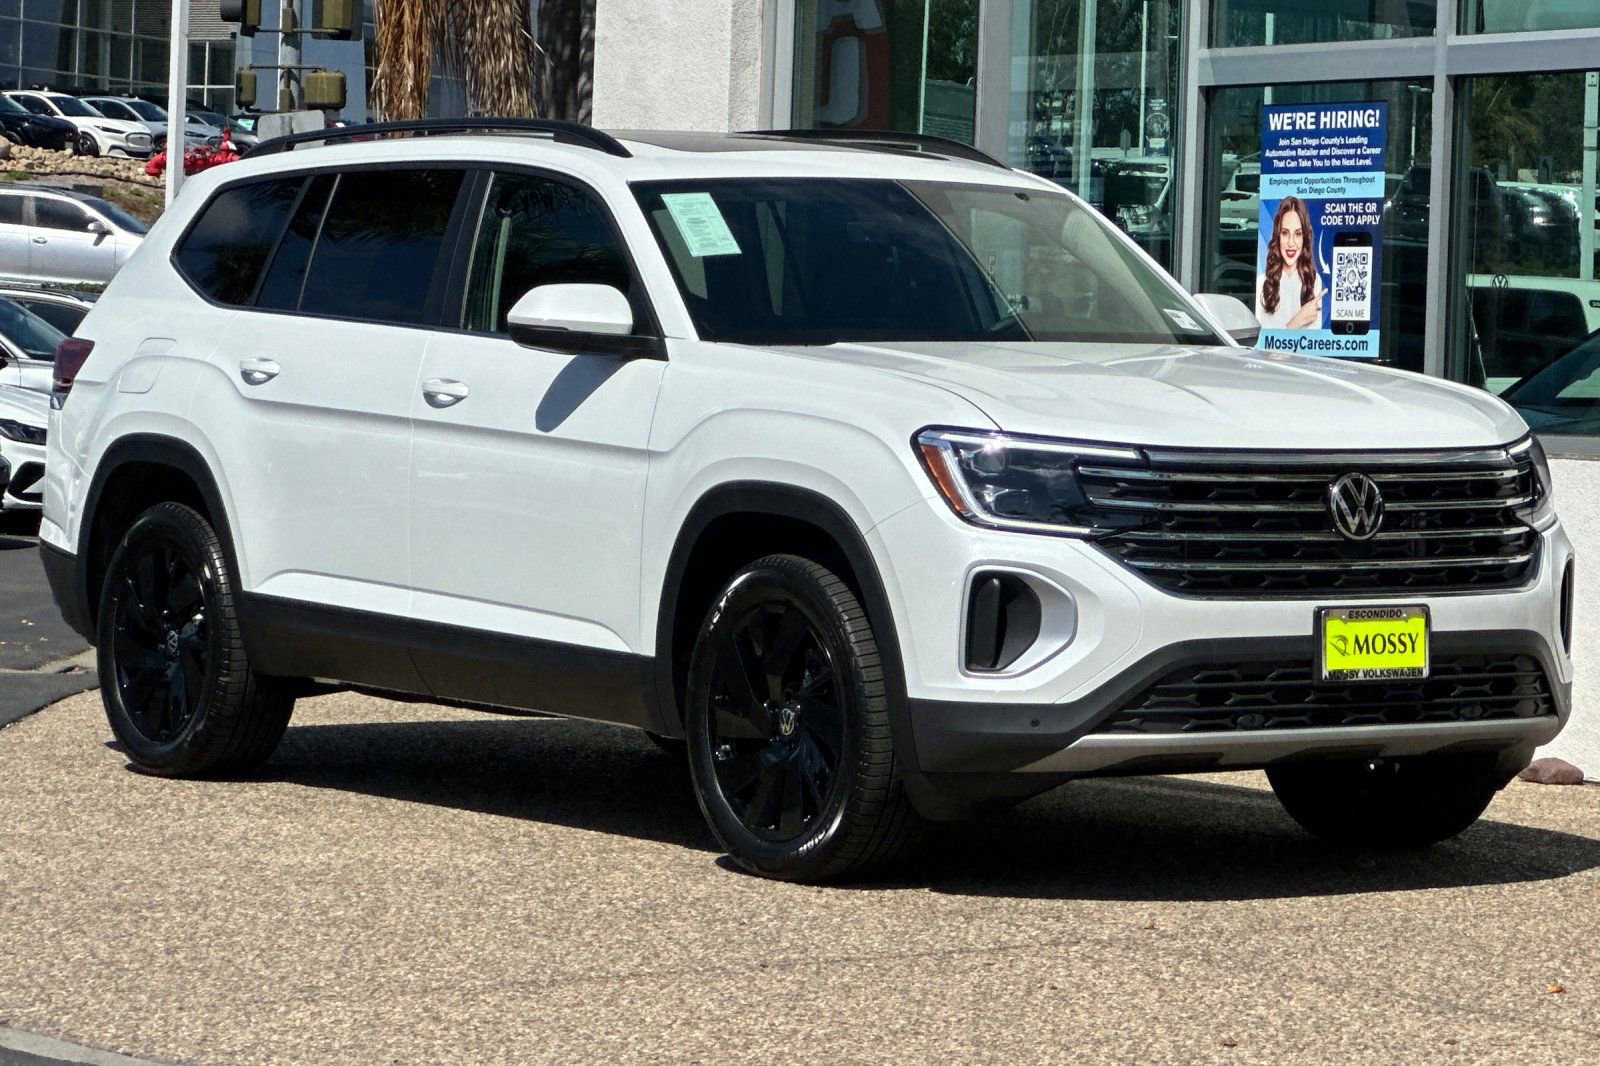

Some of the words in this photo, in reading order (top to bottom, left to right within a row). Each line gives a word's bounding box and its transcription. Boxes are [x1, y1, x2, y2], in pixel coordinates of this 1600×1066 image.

[1269, 112, 1316, 131] WE'RE
[1320, 109, 1380, 129] HIRING!
[1279, 138, 1290, 146] Join
[1303, 137, 1320, 146] Diego
[1320, 136, 1345, 146] County's
[1346, 136, 1368, 145] Leading
[1265, 149, 1296, 157] Automotive
[1297, 148, 1318, 156] Retailer
[1331, 147, 1356, 155] Discover
[1362, 146, 1382, 154] Career
[1273, 160, 1285, 168] That
[1286, 159, 1297, 167] Can
[1299, 159, 1311, 167] Take
[1312, 158, 1324, 167] You
[1332, 158, 1341, 166] the
[1342, 158, 1355, 166] Next
[1356, 157, 1372, 165] Level.
[1269, 178, 1302, 186] Employment
[1304, 177, 1342, 185] Opportunities
[1343, 176, 1375, 185] Throughout
[1296, 186, 1307, 194] San
[1309, 186, 1325, 195] Diego
[1326, 186, 1346, 194] County
[1325, 203, 1346, 213] SCAN
[1348, 203, 1363, 213] THE
[1365, 202, 1377, 213] QR
[1320, 215, 1343, 225] CODE
[1344, 215, 1355, 225] TO
[1356, 214, 1380, 225] APPLY
[1336, 309, 1354, 318] SCAN
[1355, 309, 1365, 318] ME
[1264, 335, 1368, 352] MossyCareers.com
[1348, 609, 1402, 619] ESCONDIDO
[1353, 632, 1419, 655] MOSSY
[1328, 669, 1360, 680] MOSSY
[1362, 668, 1423, 678] VOLKSWAGEN
